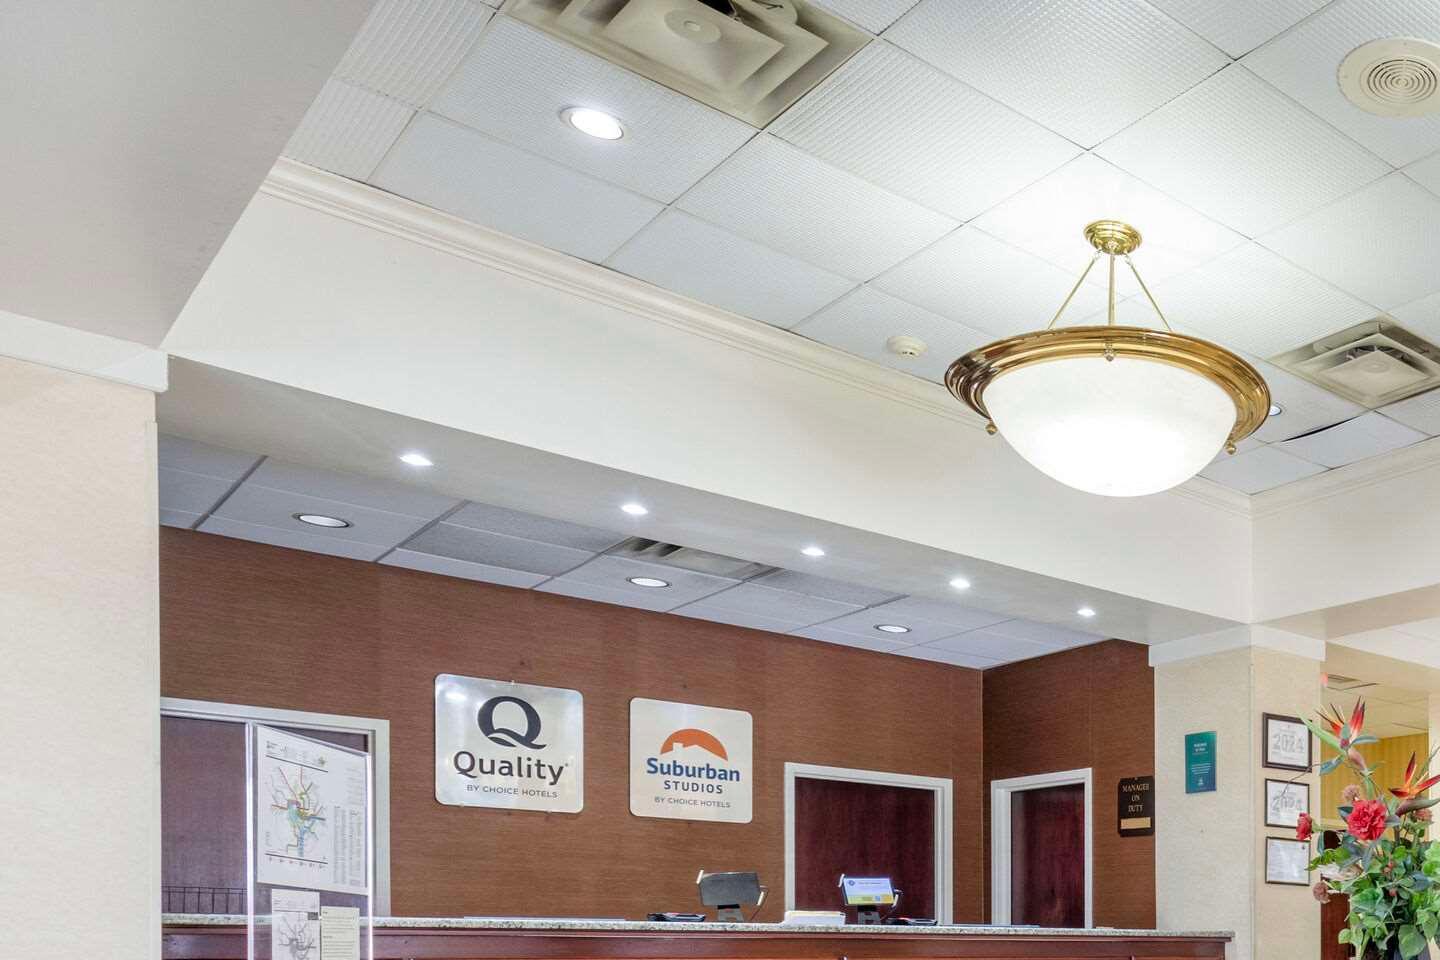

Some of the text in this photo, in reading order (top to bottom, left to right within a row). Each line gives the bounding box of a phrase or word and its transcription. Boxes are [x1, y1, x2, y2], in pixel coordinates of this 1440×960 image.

[477, 695, 547, 750] Q
[453, 750, 565, 786] Quality
[646, 757, 741, 782] Suburban
[467, 784, 558, 798] BY CHOICE HOTELS
[664, 780, 723, 794] STUDIOS
[1122, 783, 1150, 793] MANAGER
[654, 796, 731, 809] BY CHOICE HOTELS
[1131, 794, 1140, 802] ON
[1128, 804, 1143, 813] DUTY
